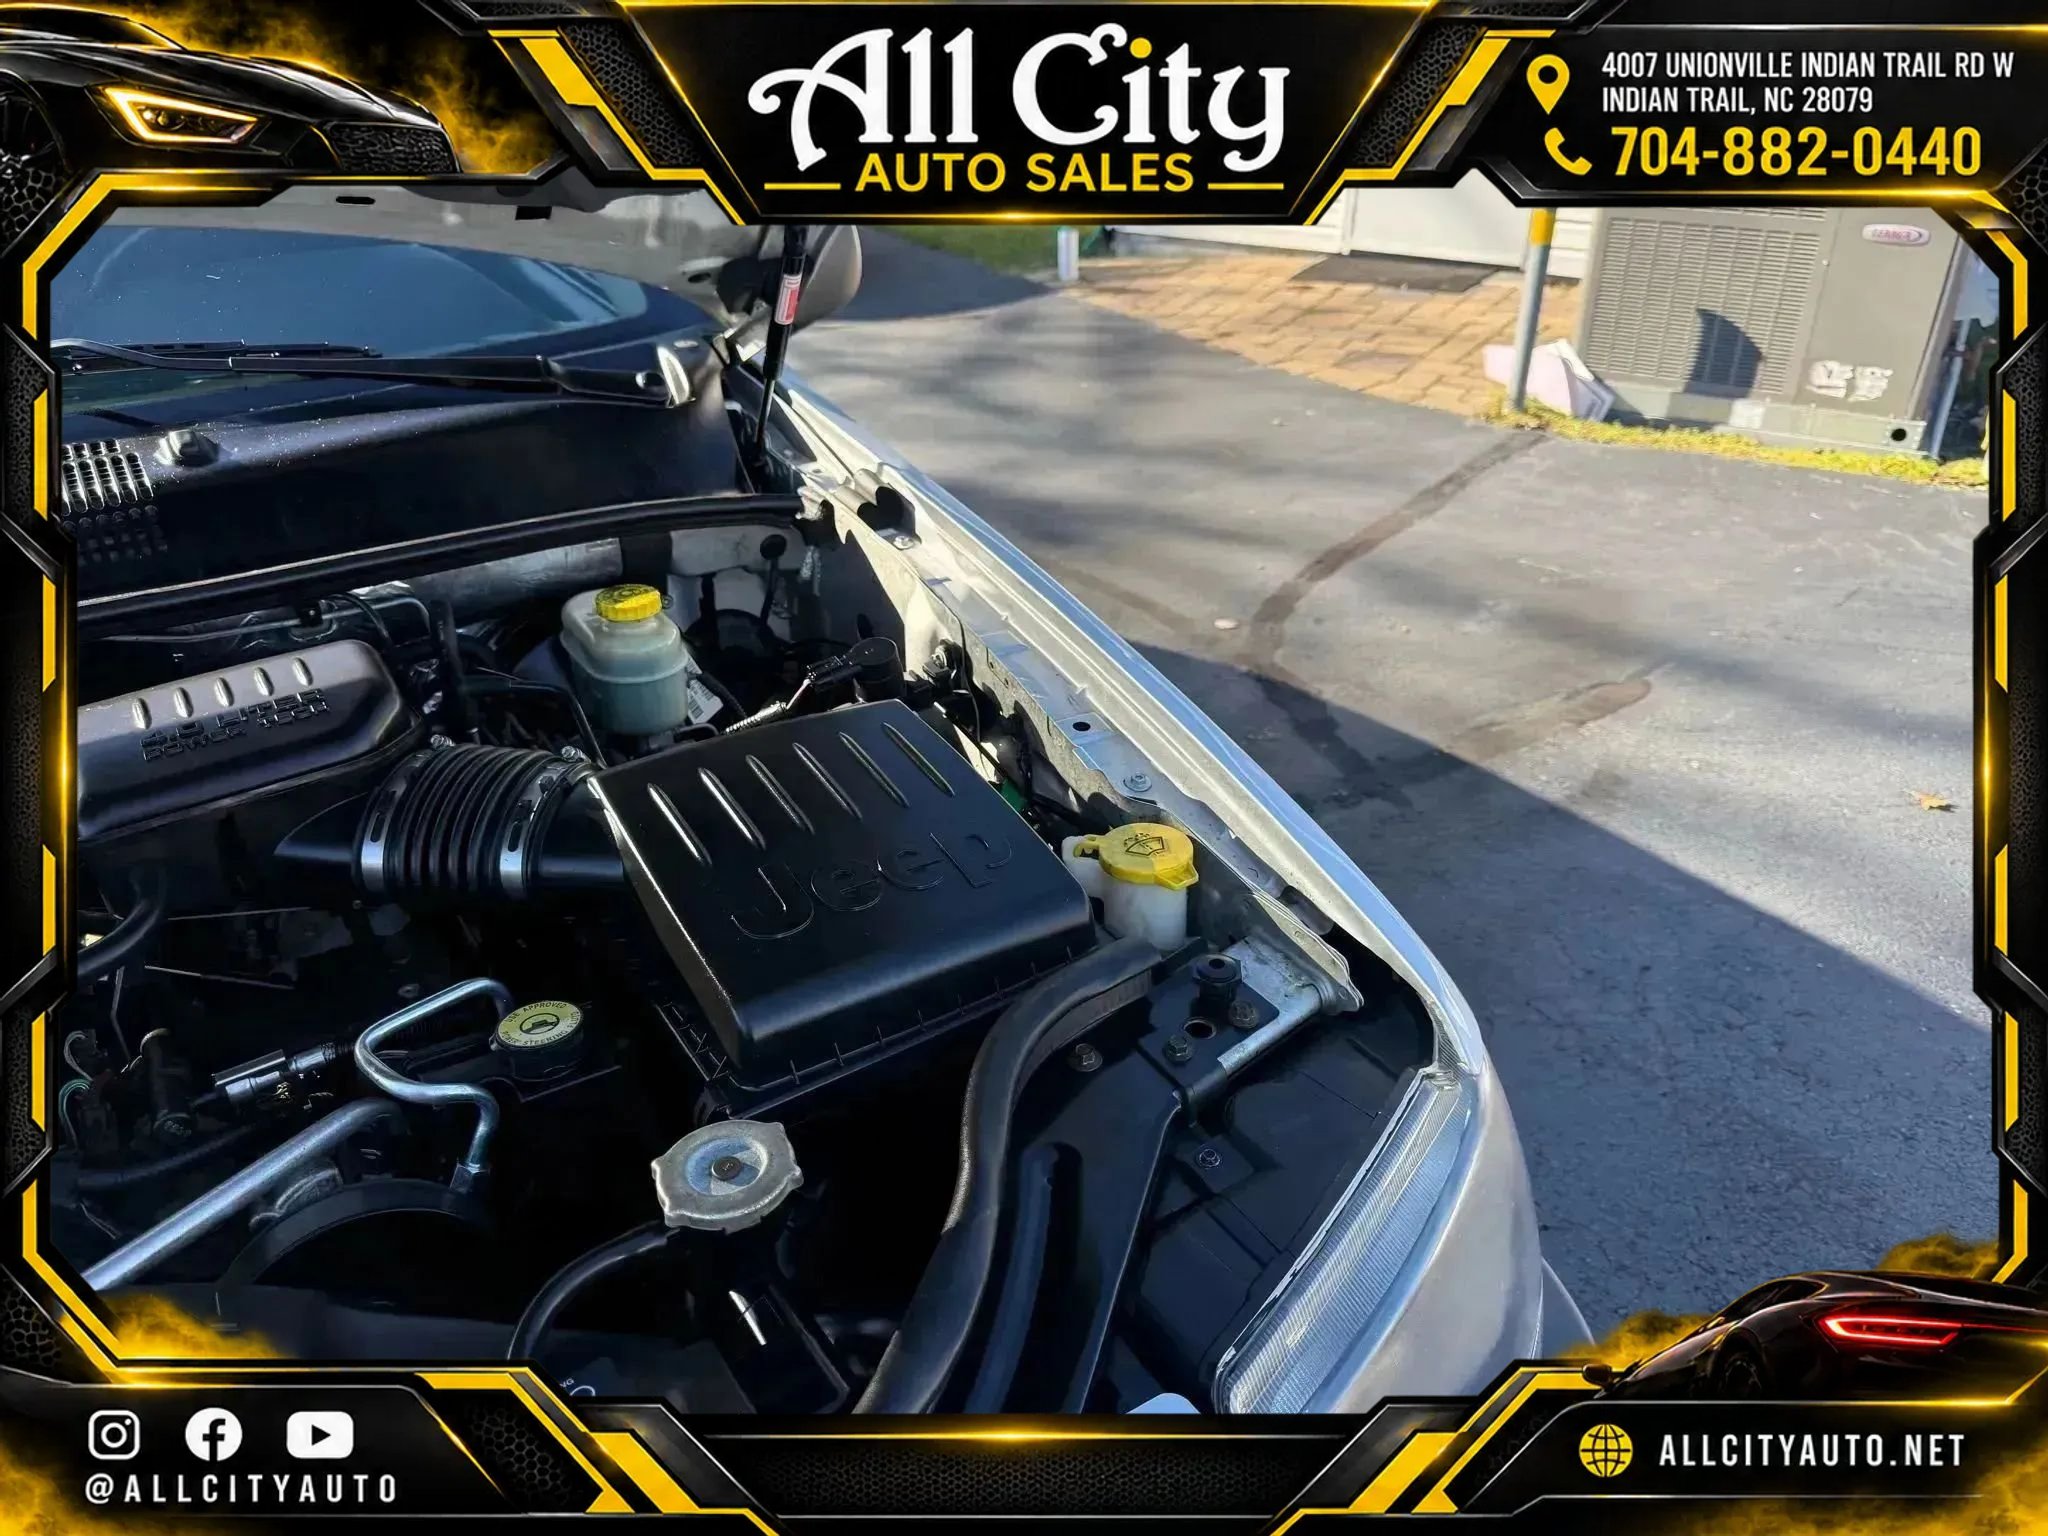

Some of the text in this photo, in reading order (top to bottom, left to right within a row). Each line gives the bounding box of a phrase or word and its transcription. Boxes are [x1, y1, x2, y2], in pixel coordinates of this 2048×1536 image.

[143, 700, 331, 761] POWER TECH
[216, 687, 326, 728] LITER
[731, 832, 1013, 940] Jeep
[504, 1002, 567, 1023] USE APPROVED
